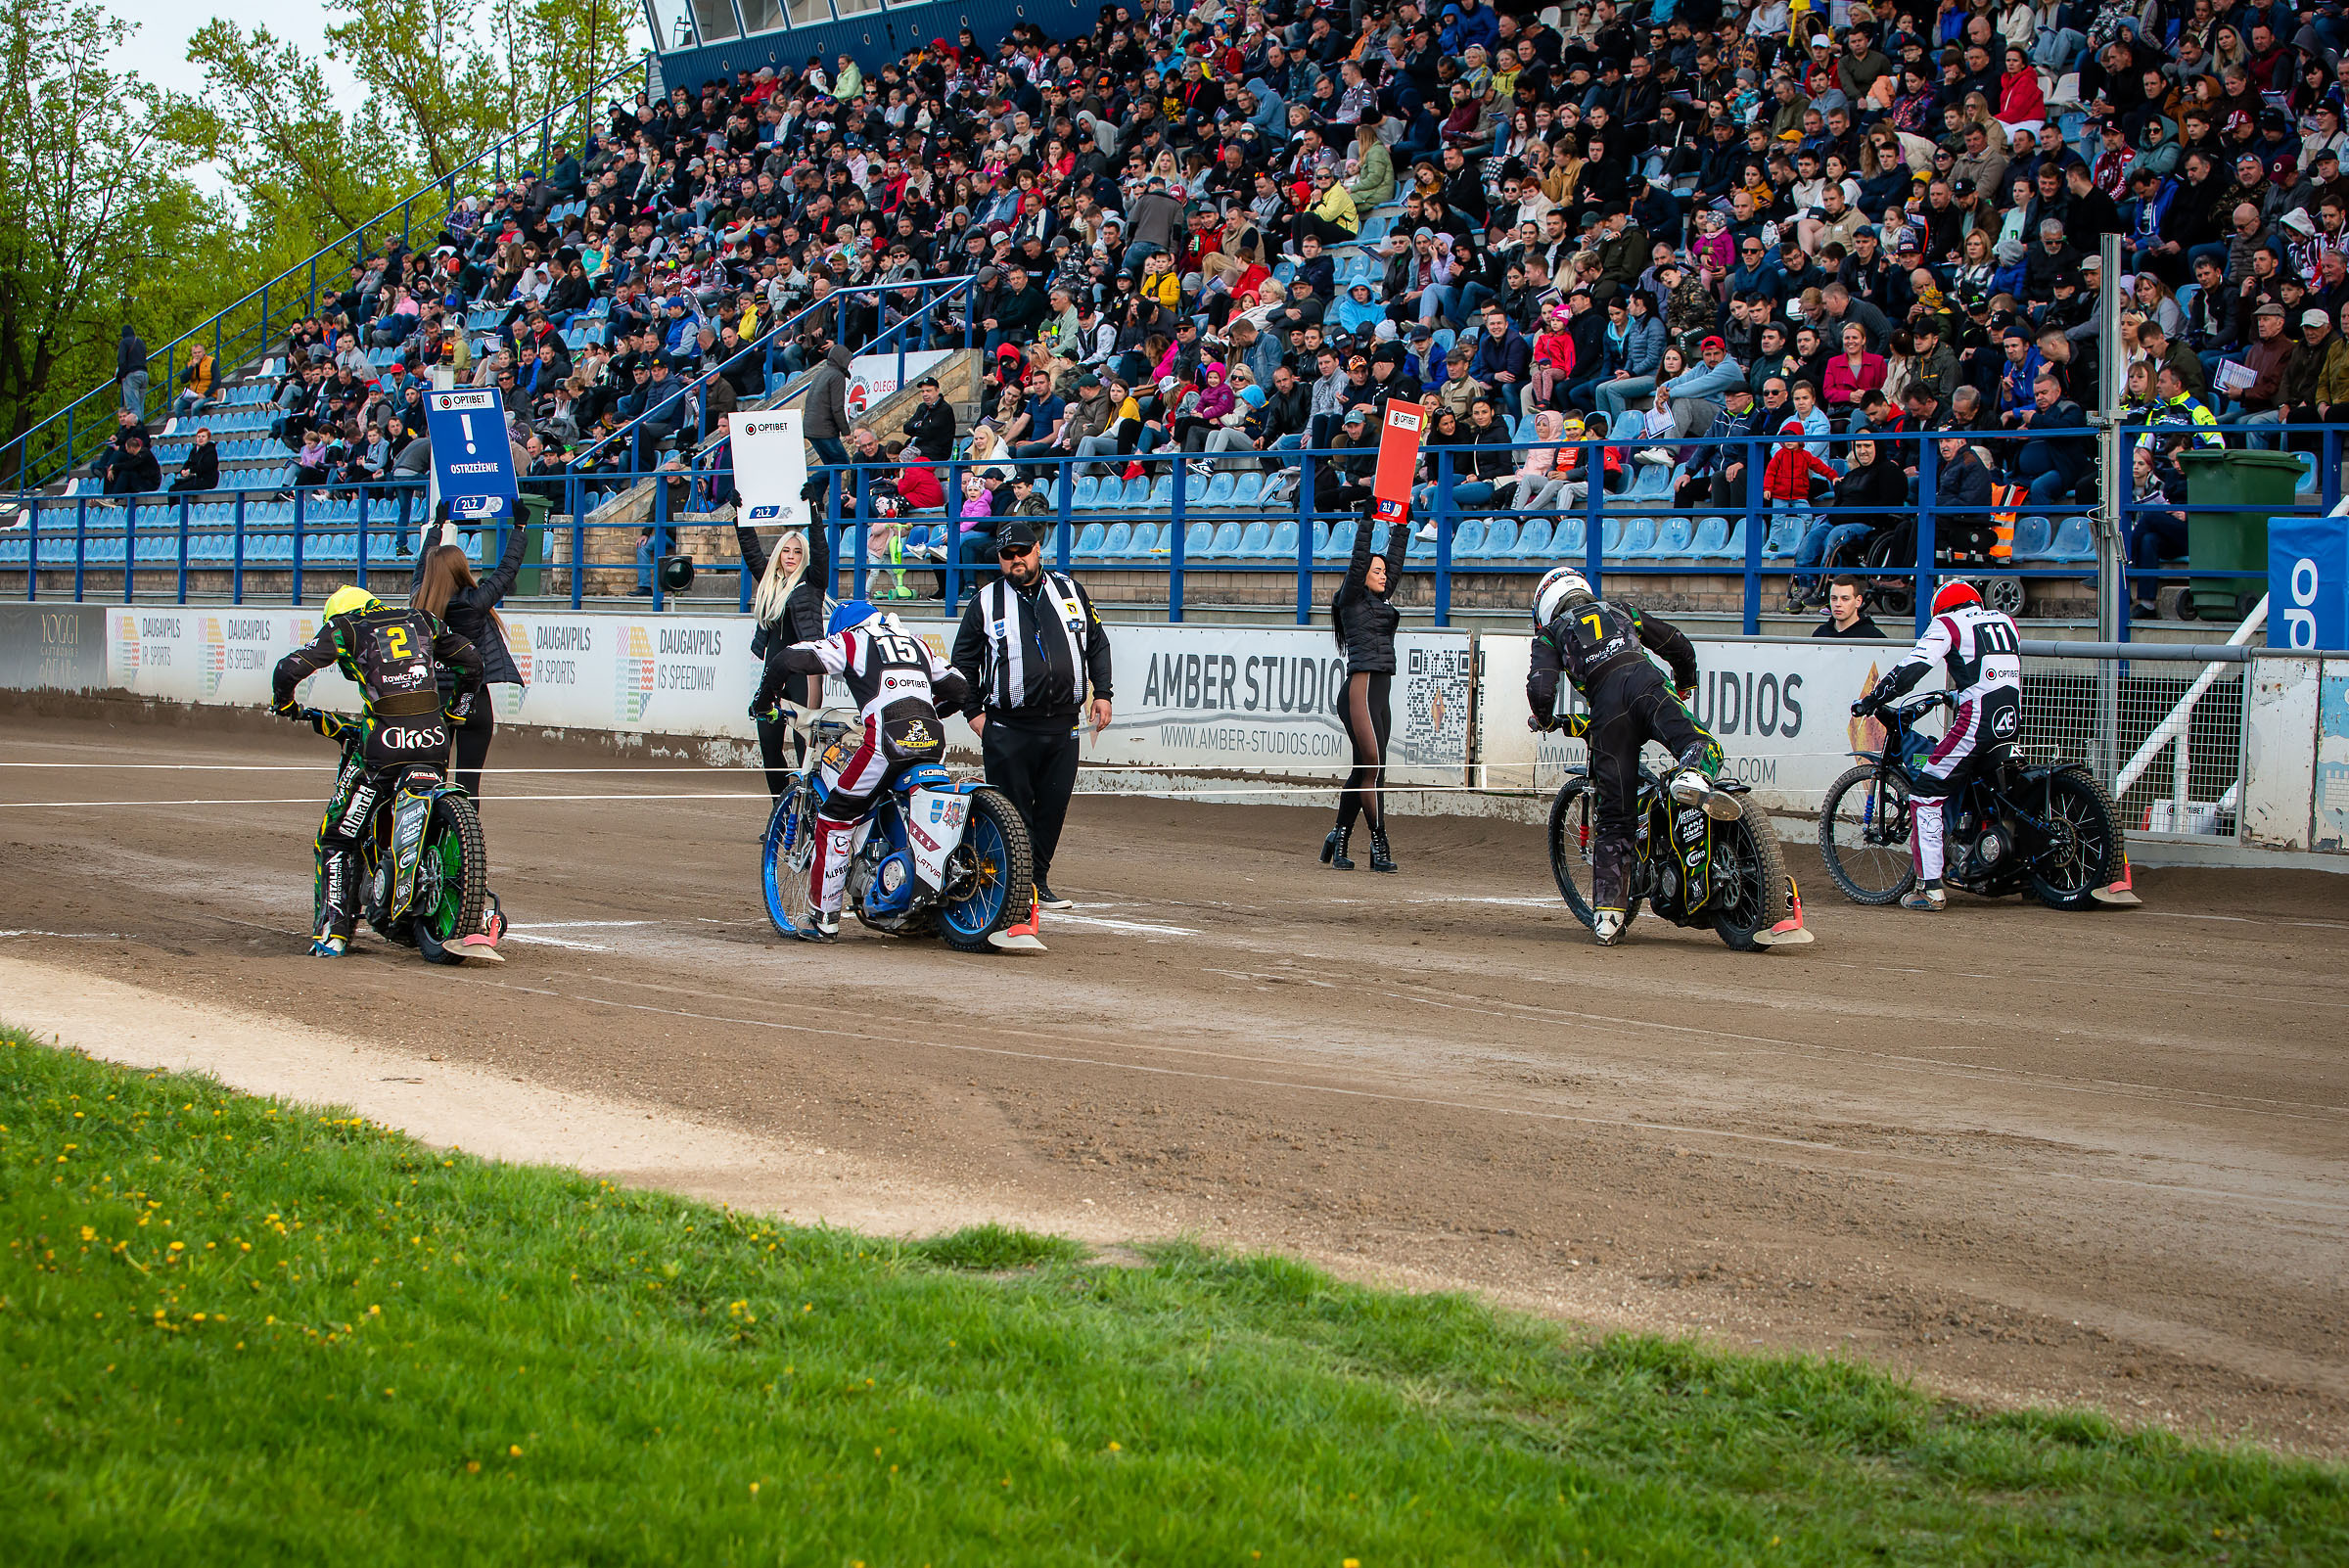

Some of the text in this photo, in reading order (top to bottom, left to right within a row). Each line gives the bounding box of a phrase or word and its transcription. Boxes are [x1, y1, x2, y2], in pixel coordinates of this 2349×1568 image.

[873, 379, 897, 392] OLEGS
[453, 394, 485, 405] OPTIBET
[758, 422, 788, 432] OPTIBET
[1400, 414, 1416, 427] OPTIBET
[450, 461, 499, 475] OSTRZEŻENIE
[756, 506, 772, 518] 2LŻ
[42, 614, 79, 645] YOGGI
[142, 618, 182, 639] DAUGAVPILS
[228, 619, 271, 641] DAUGAVPILS
[536, 625, 591, 652] DAUGAVPILS
[1580, 613, 1603, 641] 7
[1984, 623, 2011, 652] 11
[386, 626, 413, 659] 2
[660, 628, 722, 657] DAUGAVPILS
[876, 636, 918, 664] 15
[142, 646, 172, 667] IR SPORTS
[226, 646, 267, 670] IS SPEEDWAY
[382, 672, 412, 684] Rawicz
[534, 659, 576, 685] IR SPORTS
[658, 664, 716, 692] IS SPEEDWAY
[898, 678, 929, 689] OPTIBET
[1142, 652, 1346, 716] AMBER STUDIO
[1998, 669, 2019, 678] OPTIBET
[381, 725, 446, 750] Gloss
[896, 739, 939, 748] SPEEDWAY
[1160, 725, 1344, 758] WWW.AMBER-STUDIOS.COM
[340, 785, 376, 837] Almark
[916, 854, 942, 879] LATVIA
